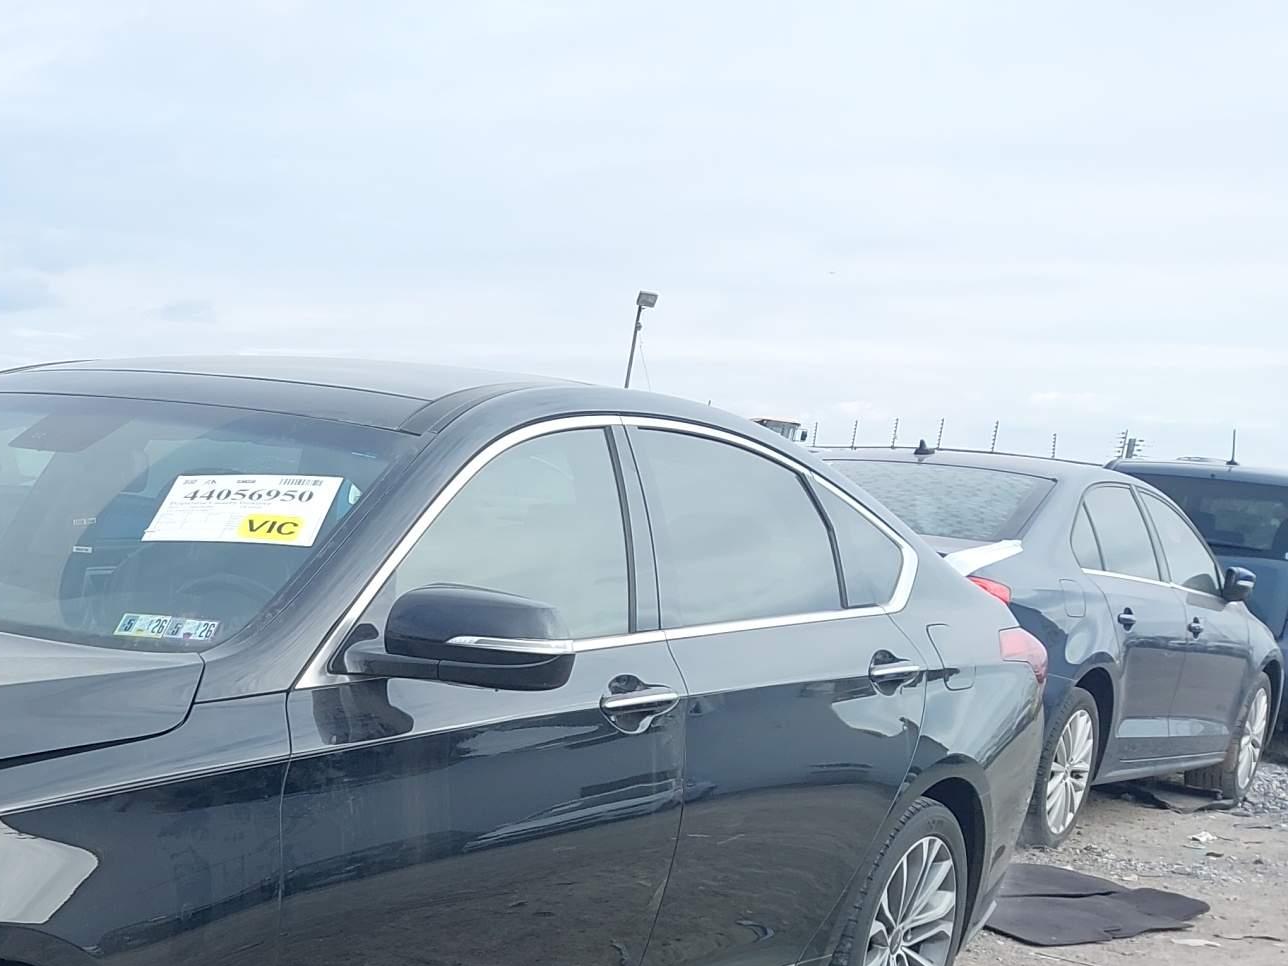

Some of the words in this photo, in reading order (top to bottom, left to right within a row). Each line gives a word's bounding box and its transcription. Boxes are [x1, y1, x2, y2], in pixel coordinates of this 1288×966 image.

[183, 489, 314, 503] 44056950
[247, 519, 299, 536] VIC
[151, 618, 168, 634] 26
[198, 622, 216, 638] 26
